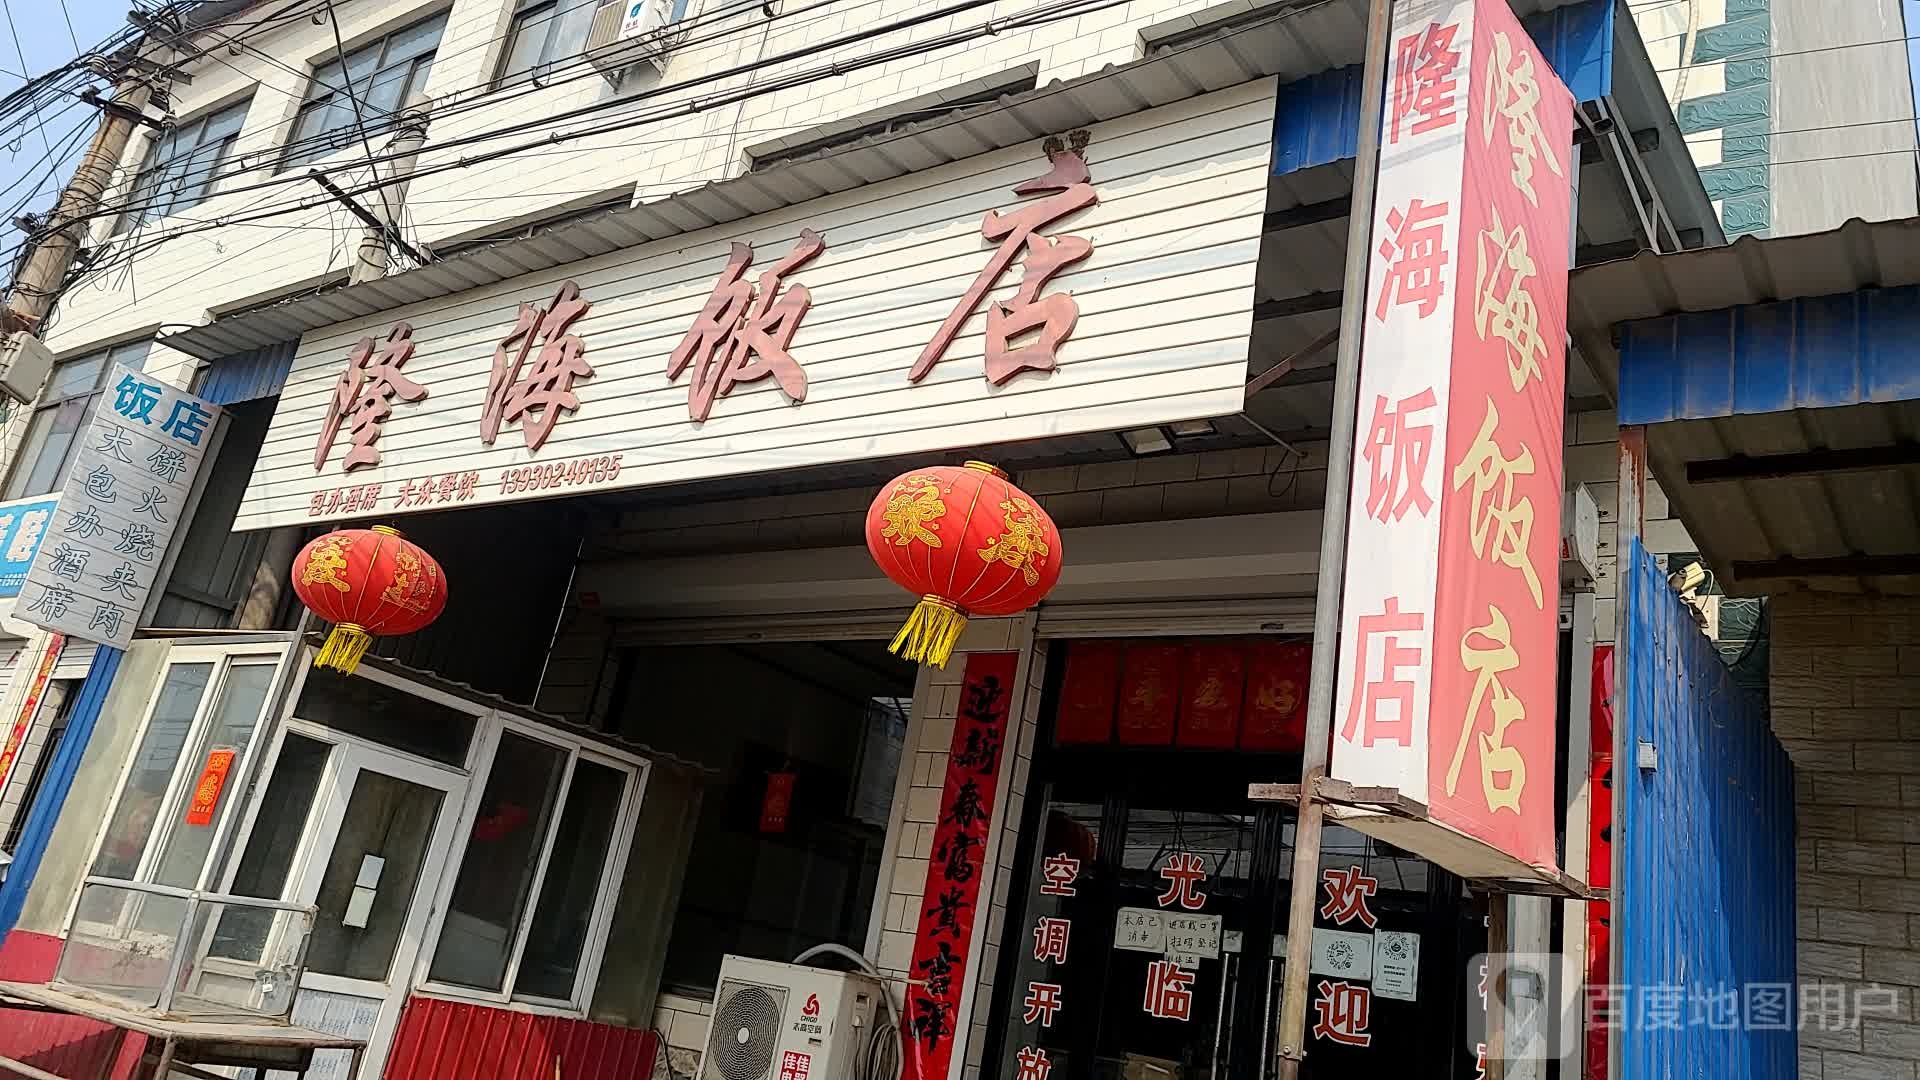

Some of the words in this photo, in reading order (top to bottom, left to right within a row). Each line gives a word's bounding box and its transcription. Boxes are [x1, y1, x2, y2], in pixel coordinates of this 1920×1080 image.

[115, 373, 213, 447] 饭店
[314, 150, 1100, 472] 隆海饭店
[1342, 21, 1462, 748] 隆海饭店
[1445, 31, 1563, 816] 隆海饭店
[309, 482, 383, 517] 包办酒席
[394, 471, 480, 508] 大众餐饮
[499, 454, 624, 496] 13930240135
[784, 1053, 810, 1073] 佳佳
[1016, 852, 1081, 1080] 空调开放
